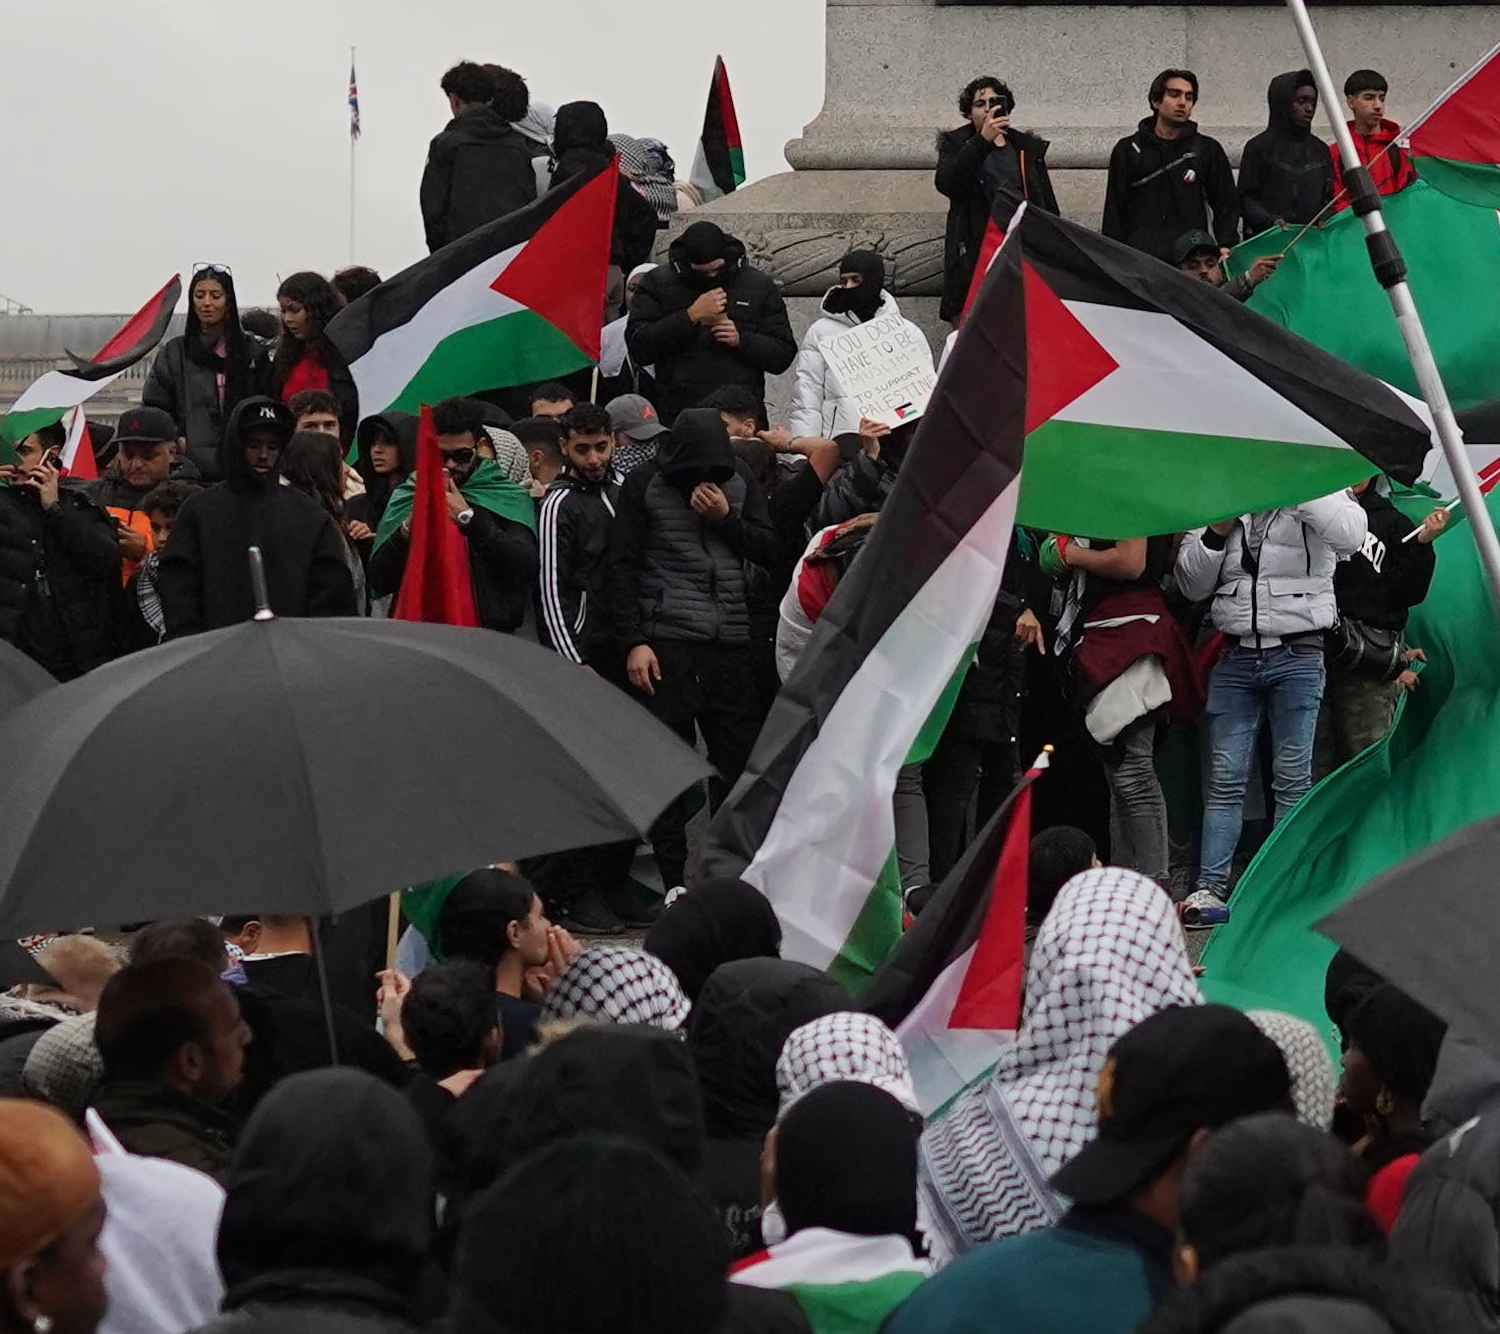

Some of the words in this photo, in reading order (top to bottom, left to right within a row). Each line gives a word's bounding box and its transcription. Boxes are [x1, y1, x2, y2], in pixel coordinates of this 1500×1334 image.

[822, 332, 862, 359] YOU
[835, 350, 873, 377] HAVE
[870, 341, 894, 357] TO
[894, 328, 920, 349] BE
[853, 390, 873, 404] TO
[876, 366, 921, 395] SUPPORT
[859, 373, 934, 418] PALESTINE
